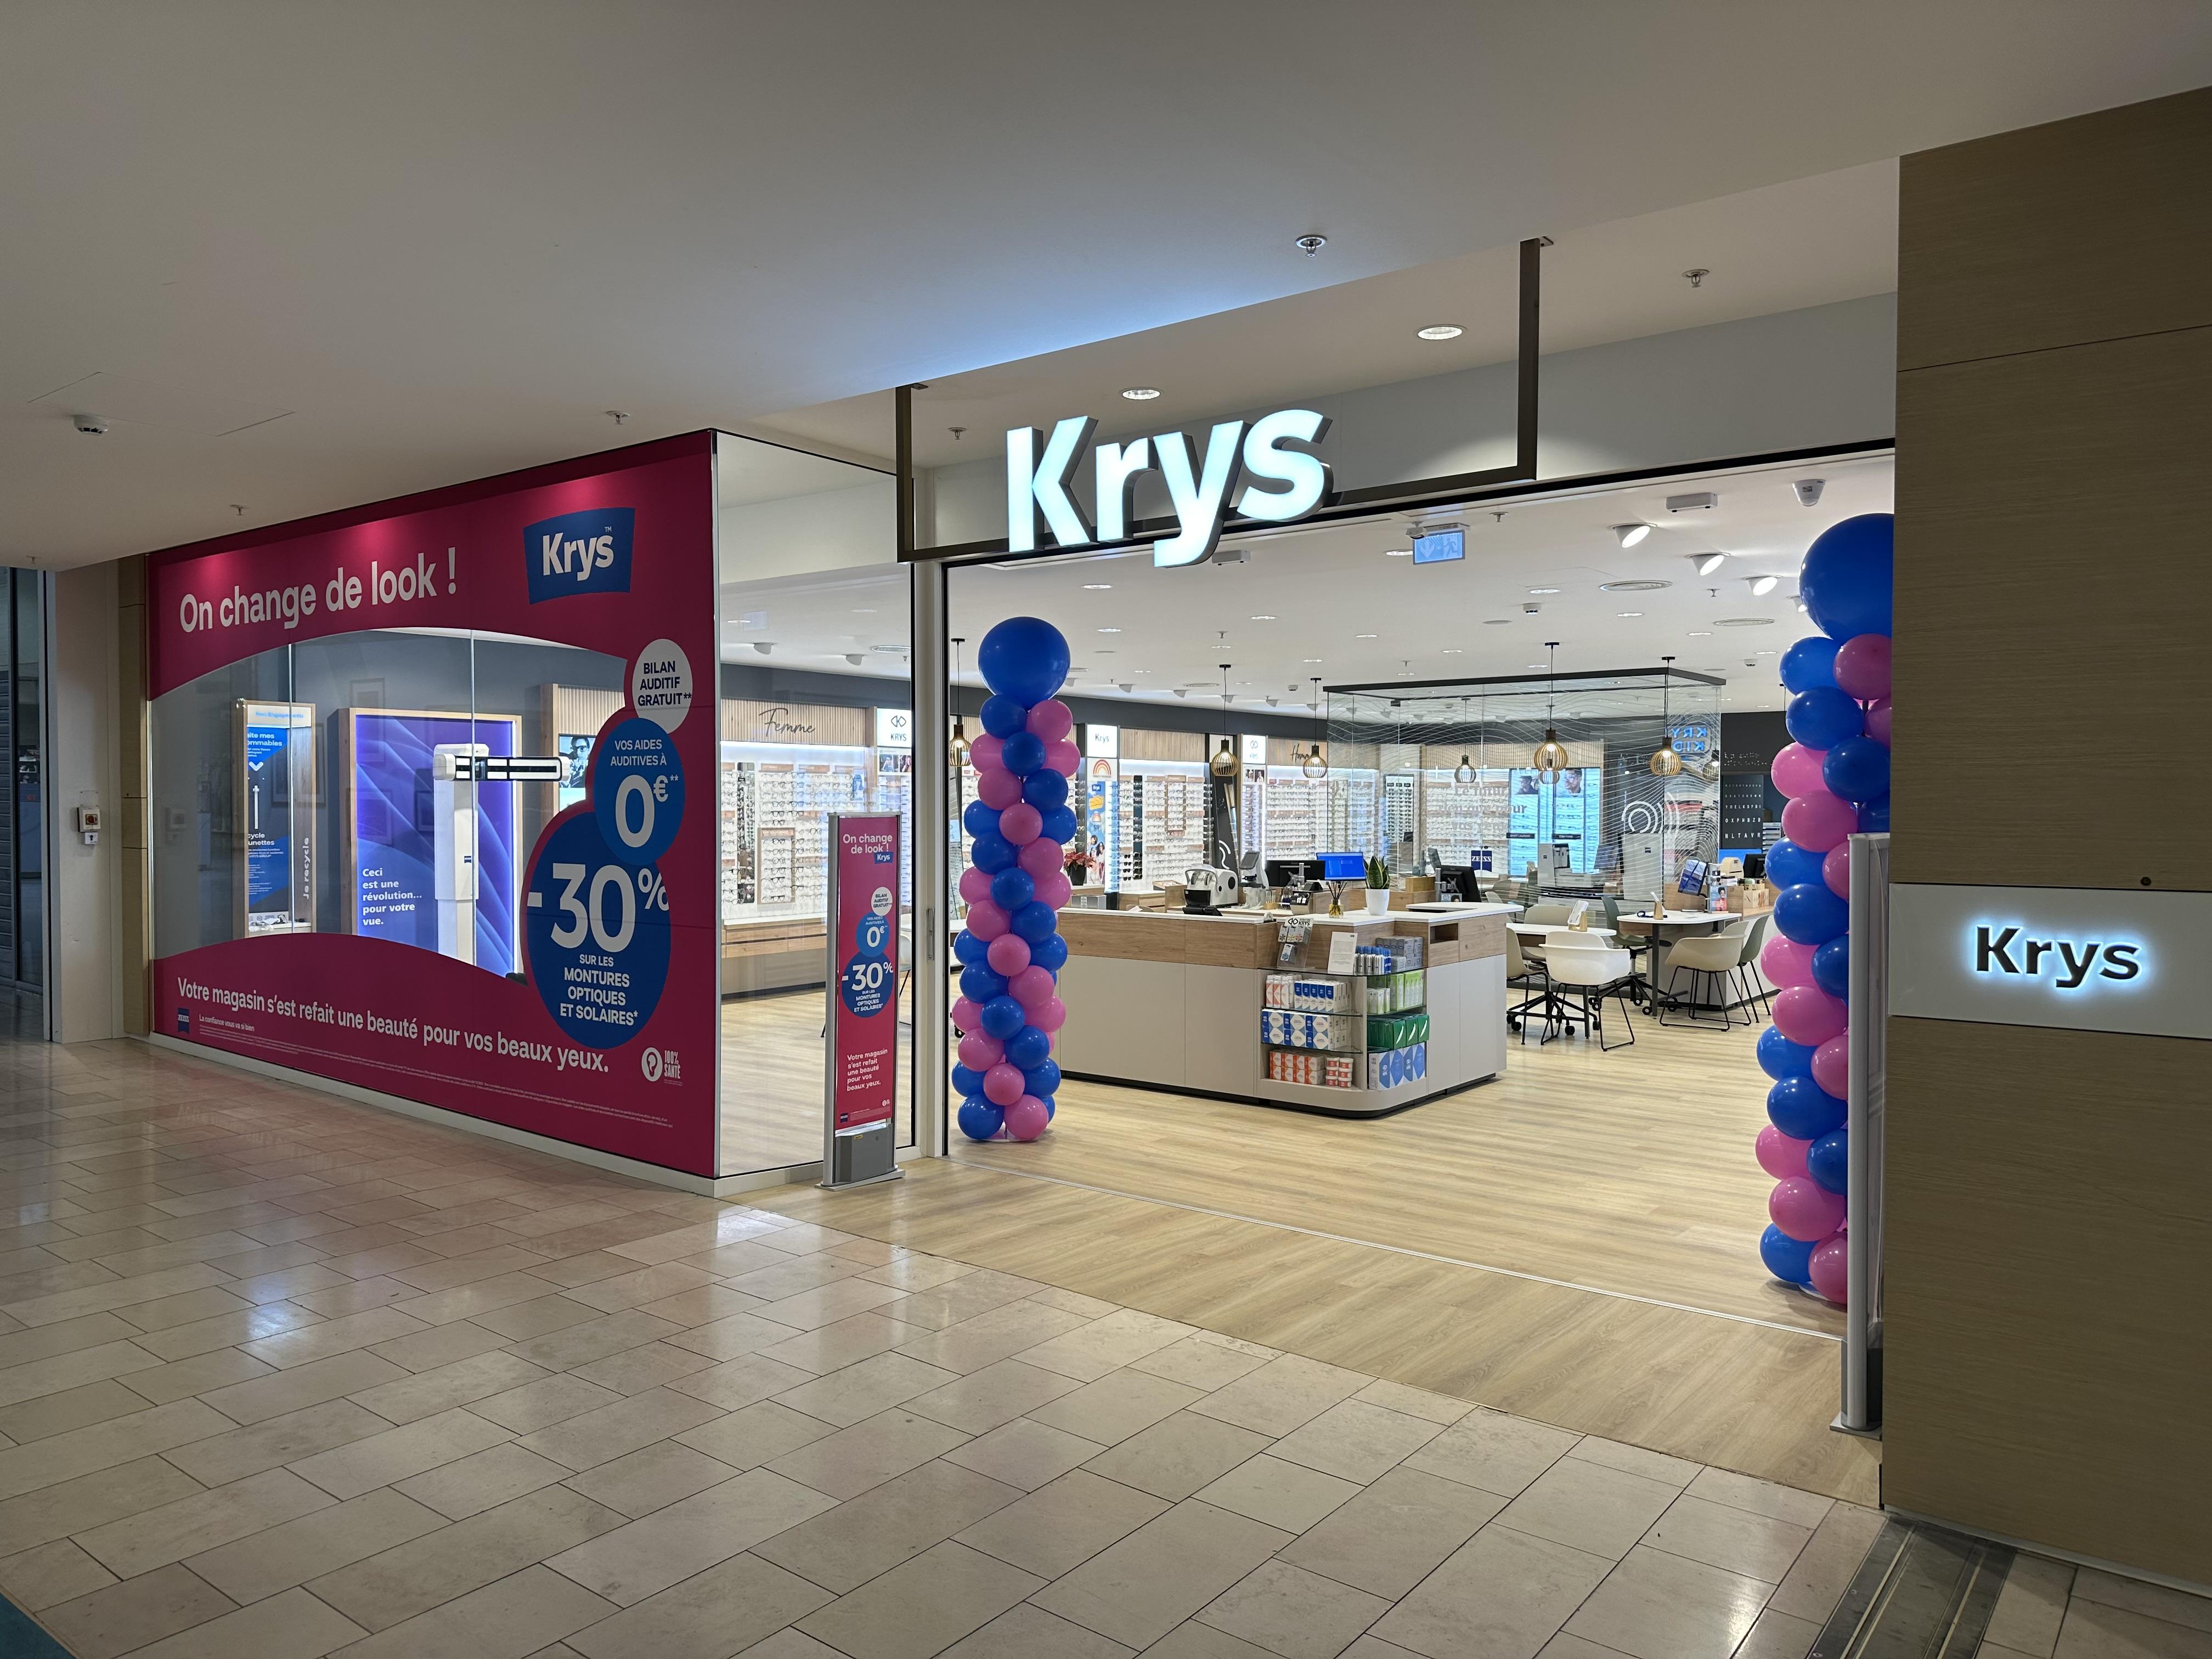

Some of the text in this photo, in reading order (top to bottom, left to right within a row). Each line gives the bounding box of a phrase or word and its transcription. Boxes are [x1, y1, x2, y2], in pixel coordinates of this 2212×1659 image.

[1006, 408, 1332, 569] Krys
[542, 532, 614, 582] Krys
[180, 547, 456, 633] On change de look !
[643, 661, 675, 675] BILAN
[640, 676, 680, 691] AUDITIF
[759, 708, 816, 737] Femme
[890, 733, 907, 742] KRYS
[1095, 733, 1109, 743] Krys
[614, 739, 662, 751] VOS AIDES
[610, 753, 667, 766] AUDITIVES À
[843, 833, 893, 845] On change
[851, 844, 862, 854] de
[865, 843, 883, 854] look
[877, 854, 890, 862] Krys
[362, 868, 383, 877] Ceci
[362, 880, 399, 889] est une
[362, 903, 415, 916] pour votre
[362, 918, 384, 927] vue.
[579, 954, 614, 967] SUR LES
[1976, 926, 2140, 988] Krys
[564, 967, 630, 988] MONTURES
[568, 986, 626, 1006] OPTIQUES
[856, 993, 881, 1001] MONTURES
[560, 1003, 573, 1018] ET
[177, 977, 209, 1002] Votre
[212, 985, 264, 1013] magasin
[299, 1002, 334, 1025] refait
[337, 1011, 364, 1030] une
[367, 1009, 418, 1039] beauté
[423, 1023, 460, 1047] pour
[464, 1031, 493, 1053] vos
[498, 1031, 552, 1064] beaux
[557, 1048, 609, 1073] yeux.
[205, 1016, 224, 1026] confiance
[245, 1023, 255, 1032] bien
[664, 1049, 679, 1065] 100%
[864, 1048, 888, 1058] magasin
[862, 1058, 878, 1066] refait
[860, 1064, 879, 1074] beauté
[847, 1076, 861, 1085] pour
[847, 1080, 881, 1092] beaux yeux.
